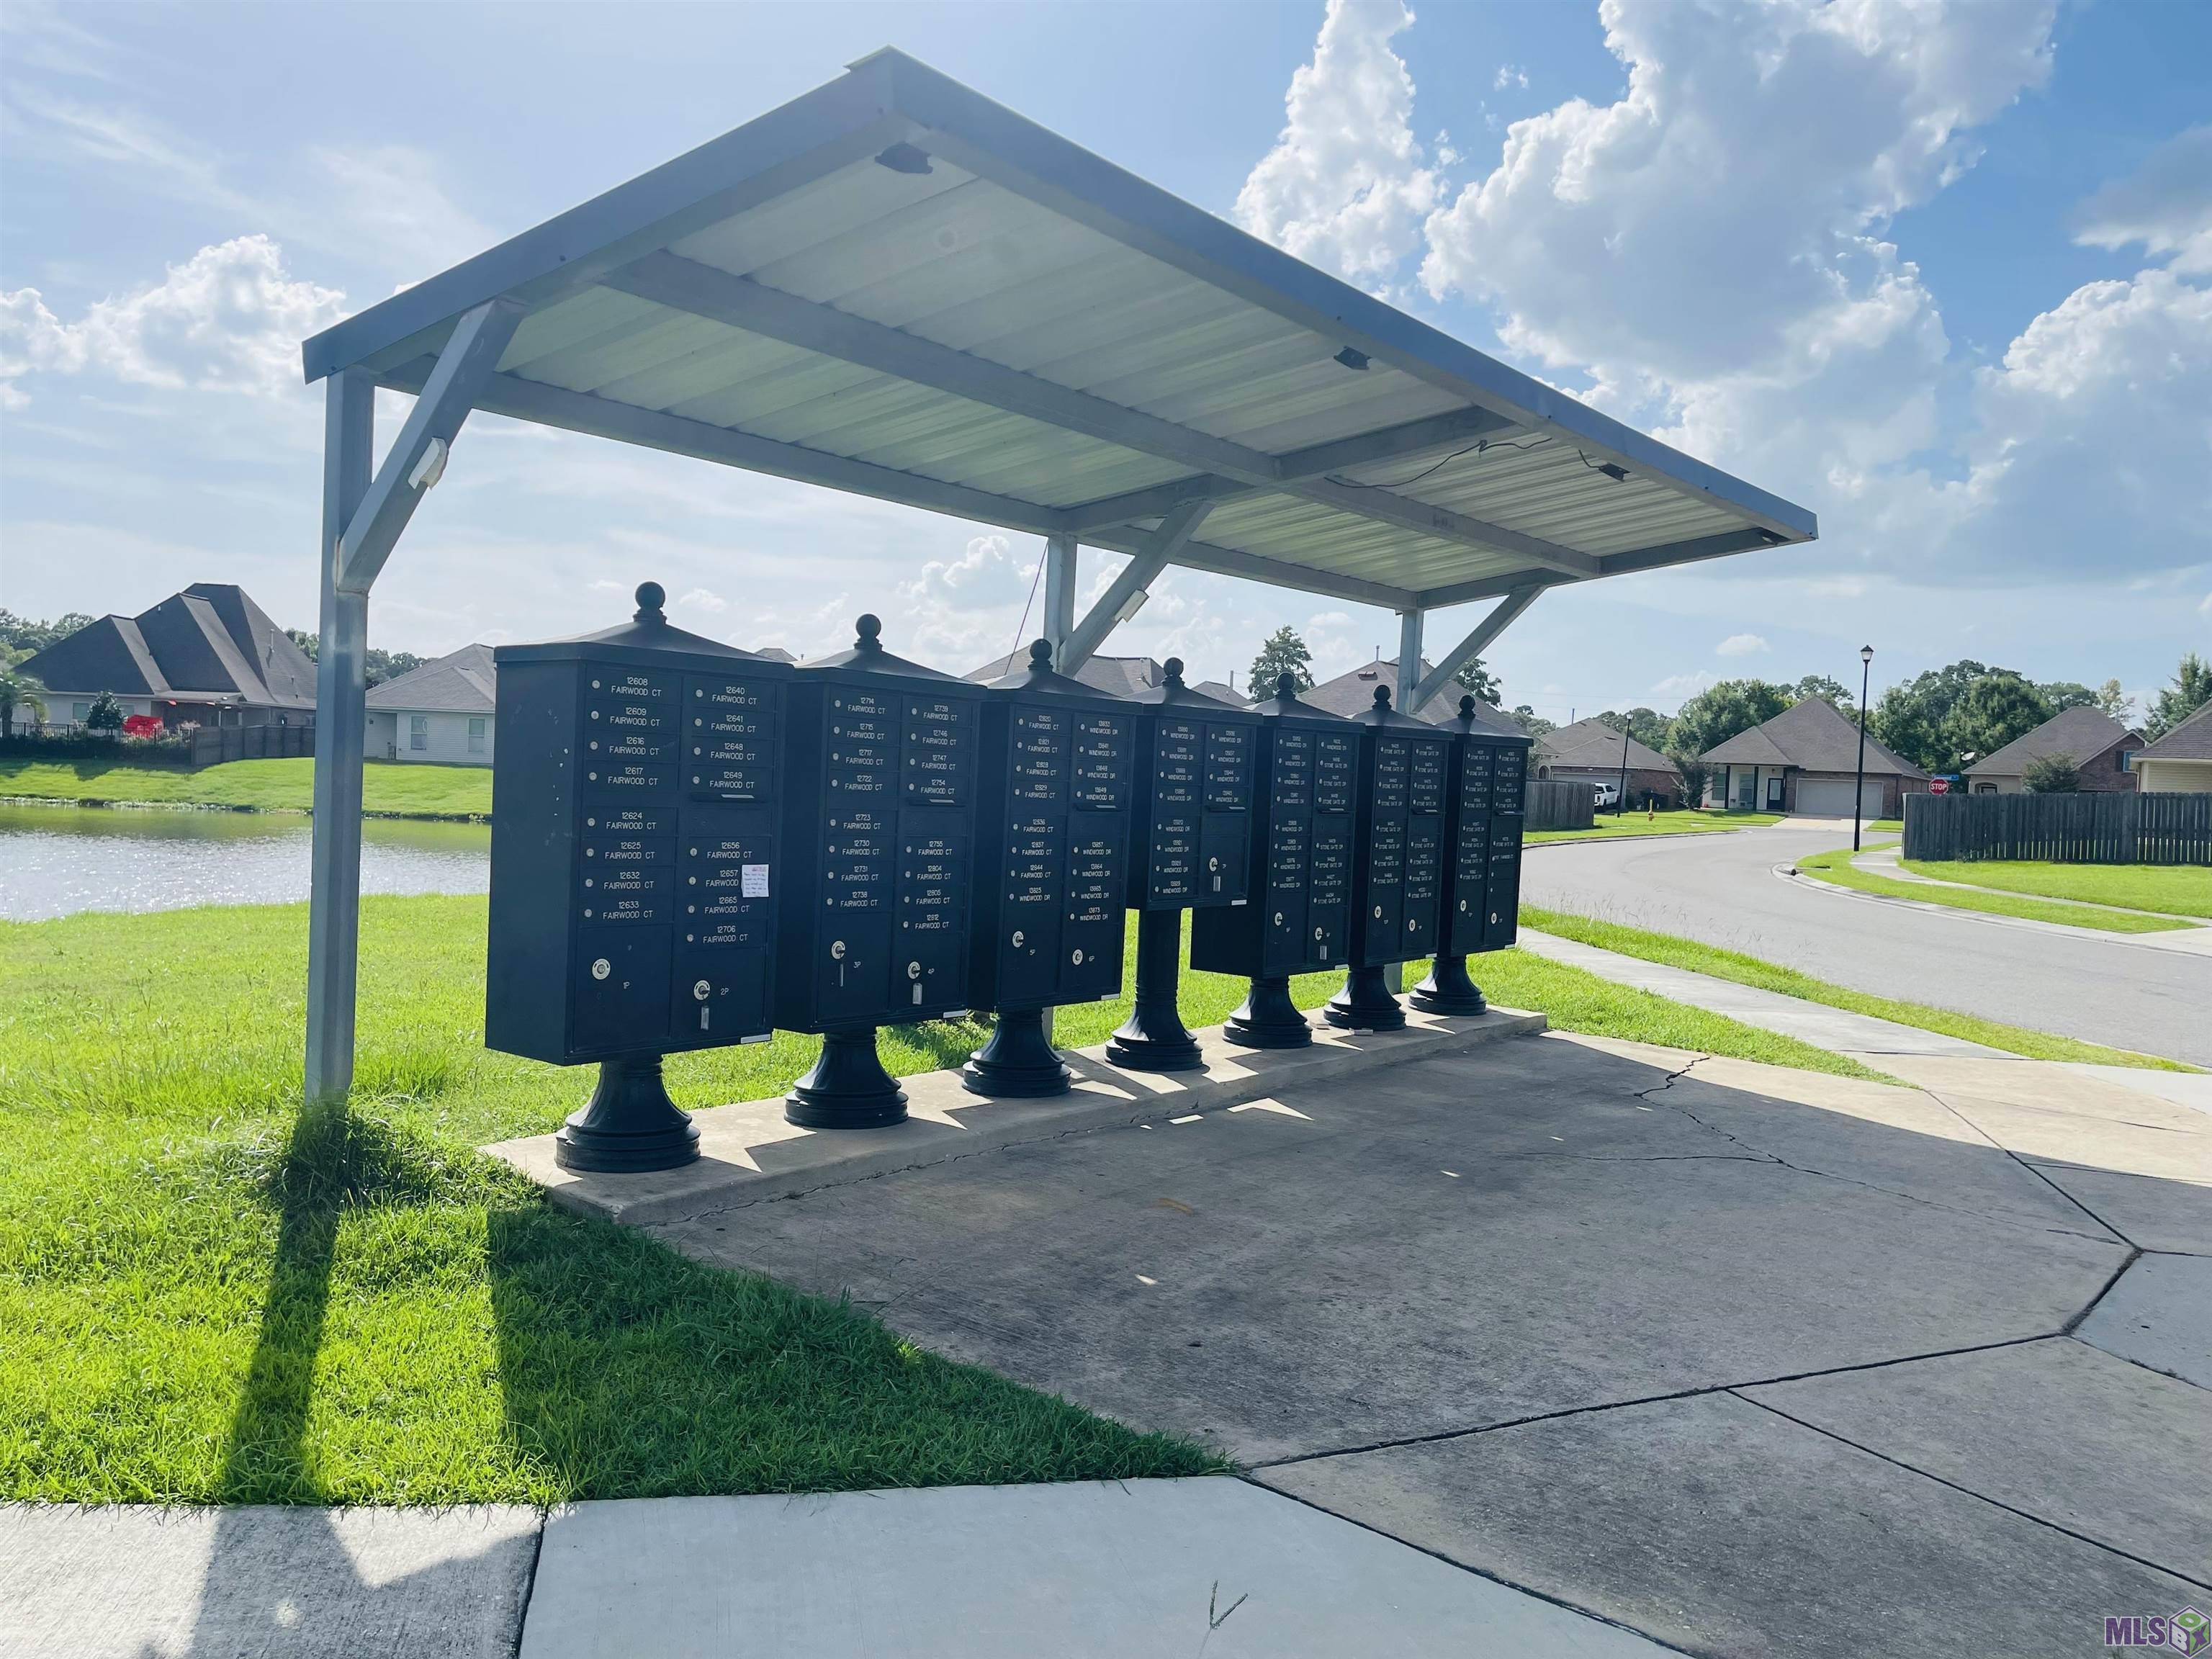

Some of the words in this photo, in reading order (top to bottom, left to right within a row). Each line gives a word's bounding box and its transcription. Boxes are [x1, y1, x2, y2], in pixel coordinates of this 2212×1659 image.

[626, 677, 648, 686] 12608
[611, 686, 648, 696] FAIRWOOD
[726, 686, 745, 695] 12640
[711, 695, 745, 704] FAIRWOOD
[626, 707, 647, 716] 12609
[848, 705, 876, 714] FAIRWOOD
[610, 716, 647, 727] FAIRWOOD
[726, 714, 743, 723] 12641
[711, 723, 744, 732] FAIRWOOD
[626, 737, 644, 745] 12616
[609, 747, 647, 755] FAIRWOOD
[711, 752, 744, 760] FAIRWOOD
[747, 752, 755, 761] CT
[845, 757, 873, 765] FAIRWOOD
[625, 767, 644, 775] 12617
[608, 776, 644, 785] FAIRWOOD
[709, 780, 742, 788] FAIRWOOD
[603, 911, 640, 920] FAIRWOOD
